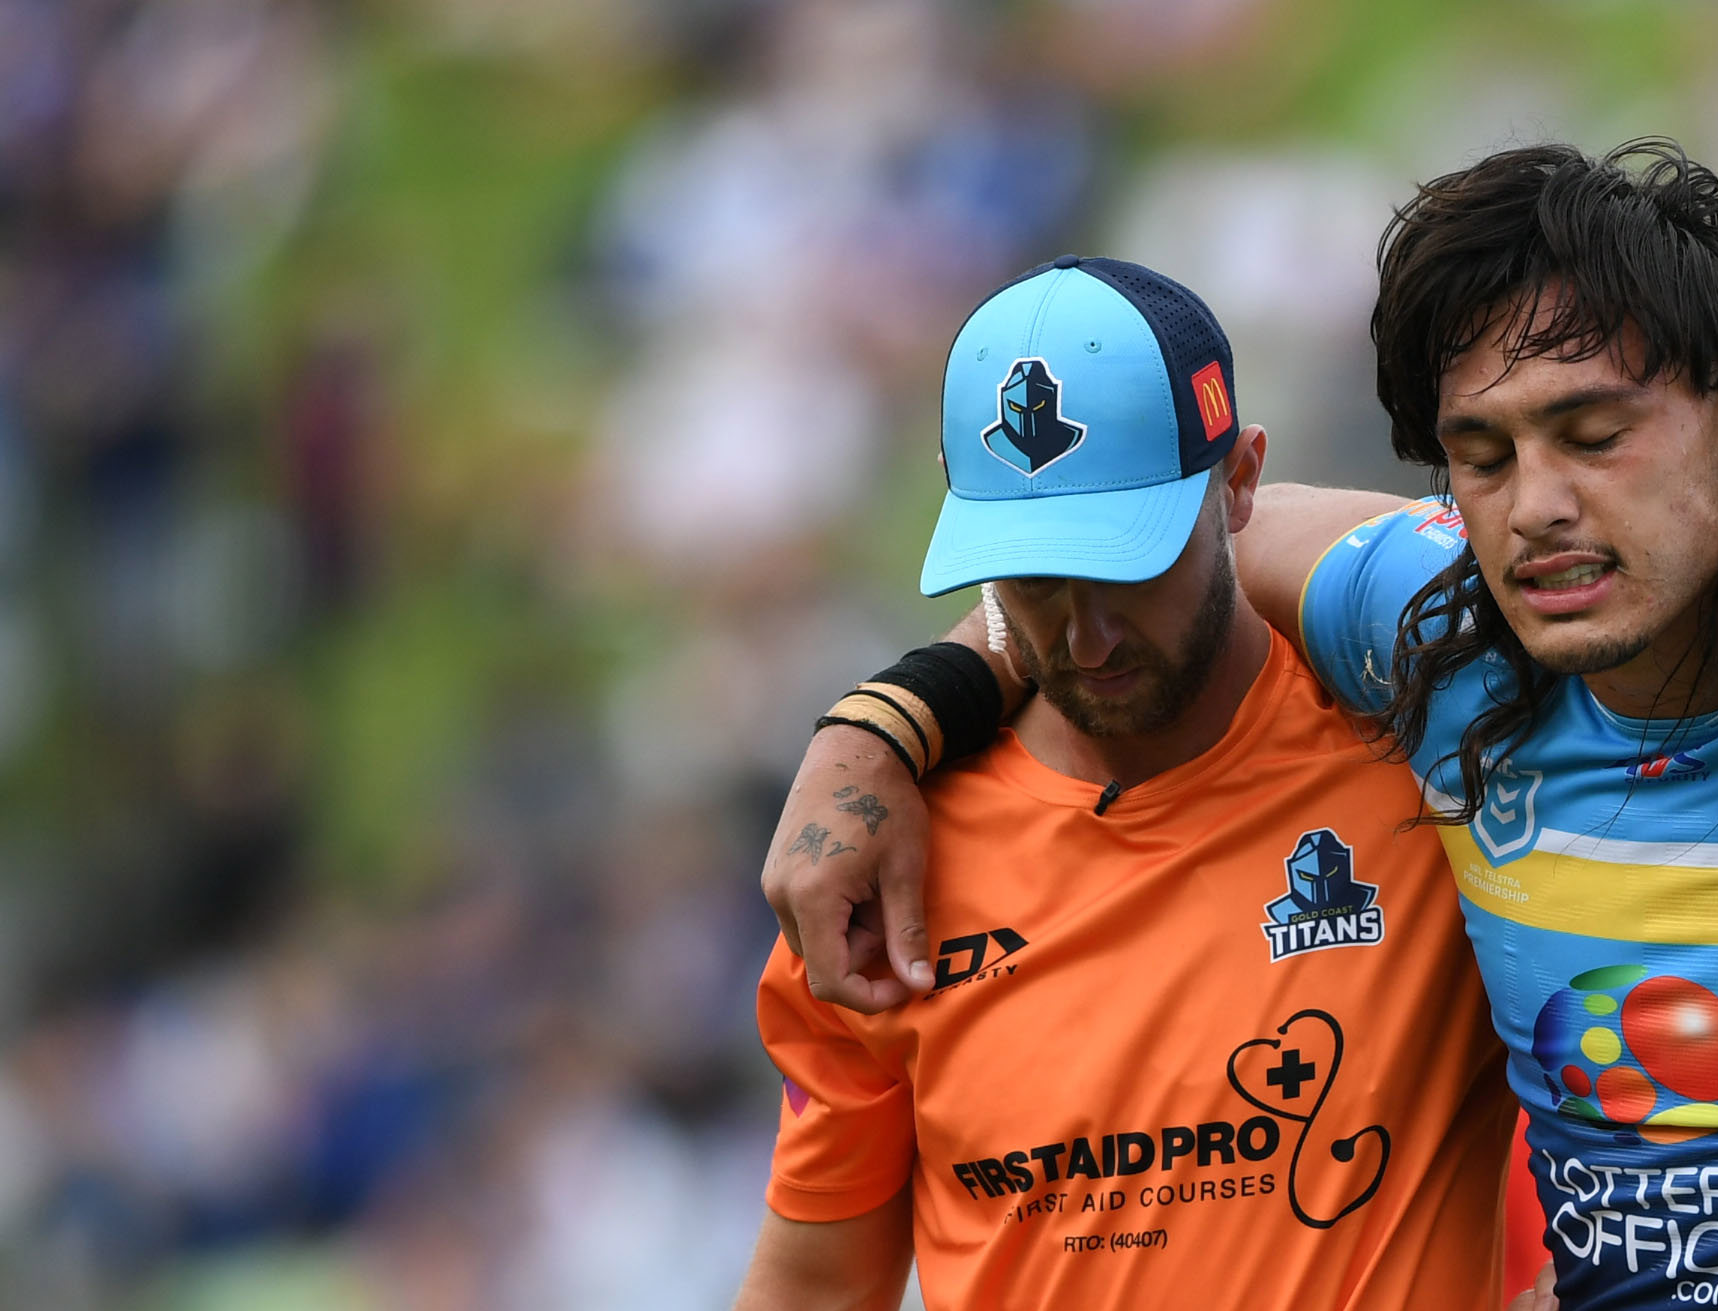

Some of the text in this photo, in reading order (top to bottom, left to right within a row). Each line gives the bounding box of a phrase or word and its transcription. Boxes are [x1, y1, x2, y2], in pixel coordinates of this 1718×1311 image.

[1463, 870, 1530, 905] PREMIERSHIP
[1484, 869, 1520, 889] TELSTRA
[1291, 905, 1353, 923] GOLD COAST
[1268, 910, 1379, 956] TITANS
[1081, 1190, 1127, 1213] AID
[1140, 1173, 1276, 1207] COURSES
[1064, 1229, 1168, 1253] RTO: (40407)
